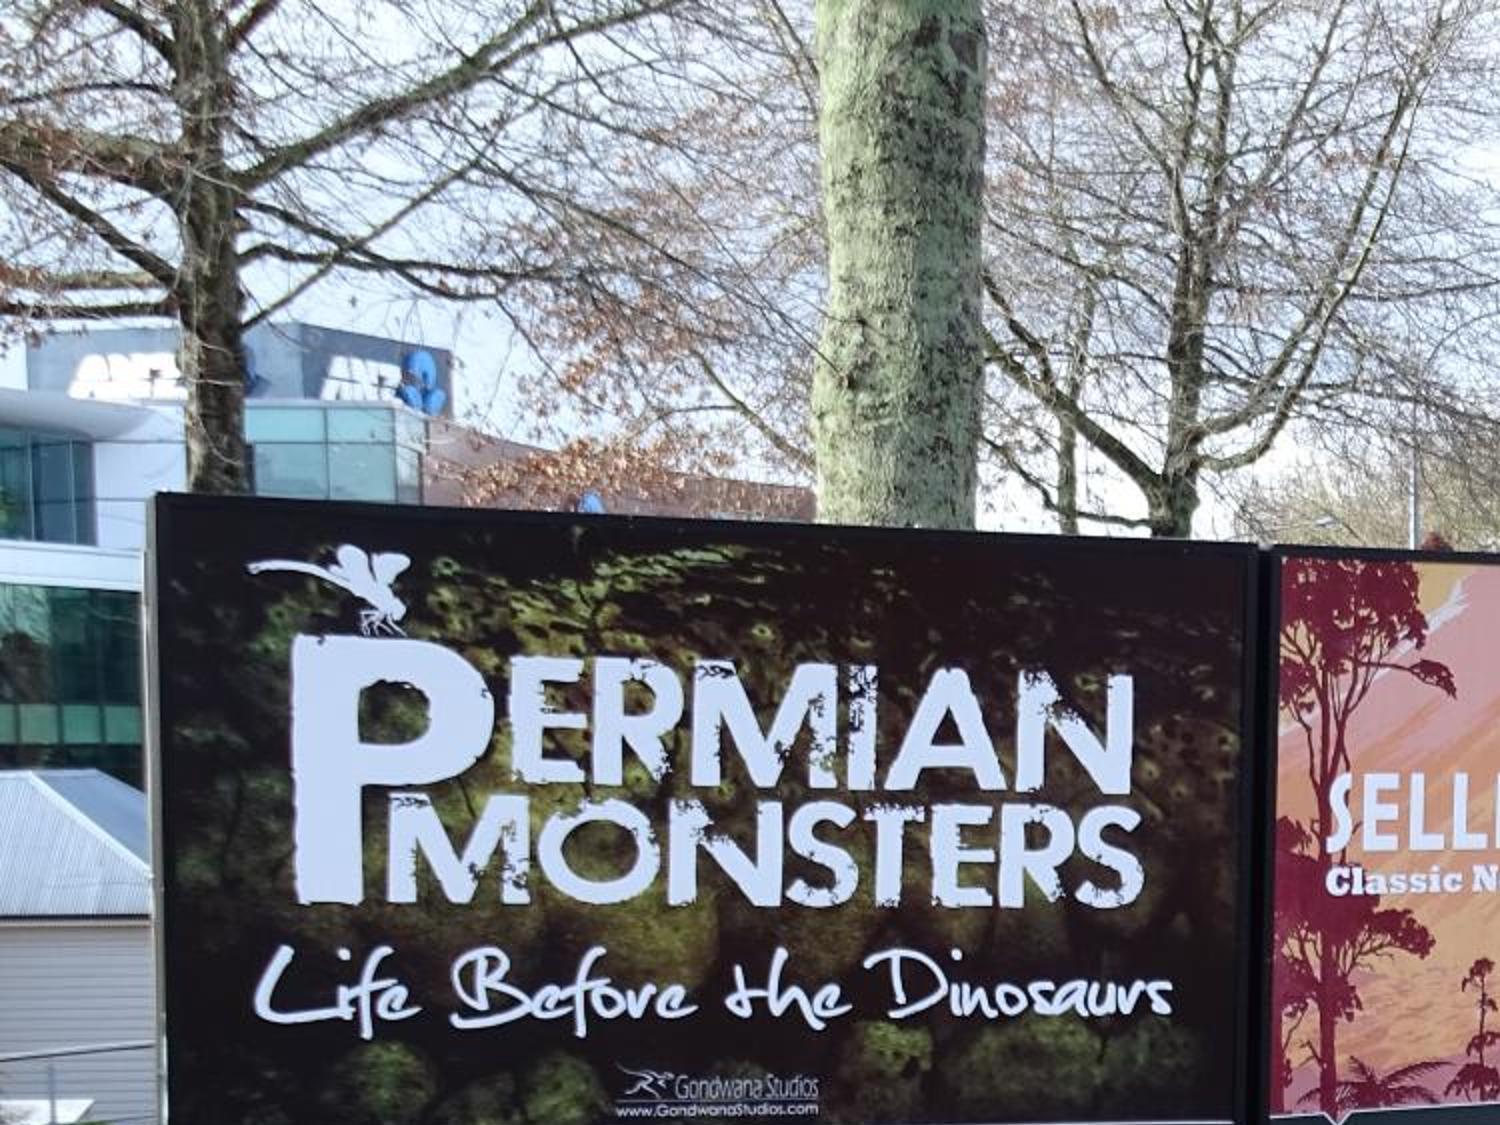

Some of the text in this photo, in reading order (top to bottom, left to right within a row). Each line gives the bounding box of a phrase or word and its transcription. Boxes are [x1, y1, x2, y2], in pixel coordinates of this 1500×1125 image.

[291, 634, 1134, 905] PERMIAN
[387, 790, 1145, 909] MONSTERS
[1326, 864, 1463, 897] Classic
[254, 945, 1173, 1039] Life Before the Dinosaurs
[616, 1103, 819, 1117] www.GondwanaStudios.com
[675, 1073, 819, 1100] Gondwana Studios
